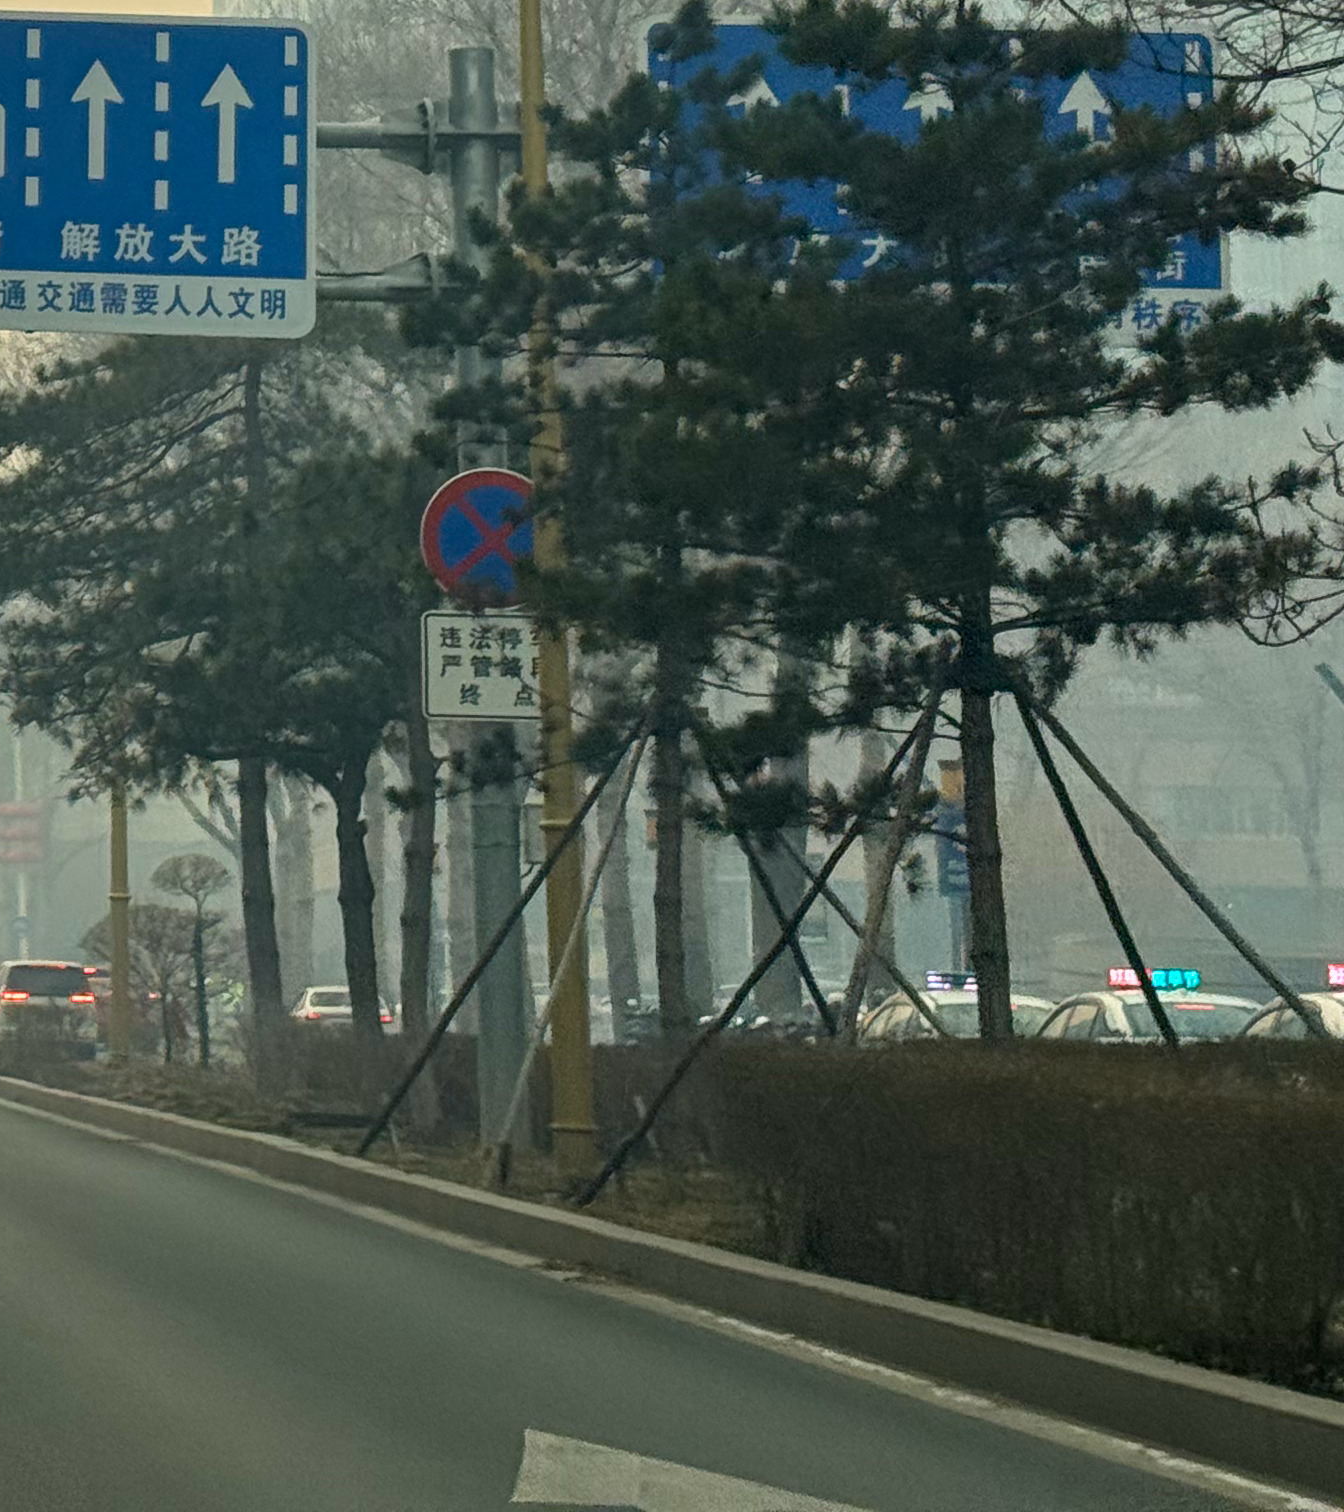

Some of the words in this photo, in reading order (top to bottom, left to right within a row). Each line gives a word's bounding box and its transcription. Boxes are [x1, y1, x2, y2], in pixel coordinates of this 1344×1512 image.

[60, 220, 263, 267] 解放大路
[37, 281, 287, 321] 交通需要人人文明
